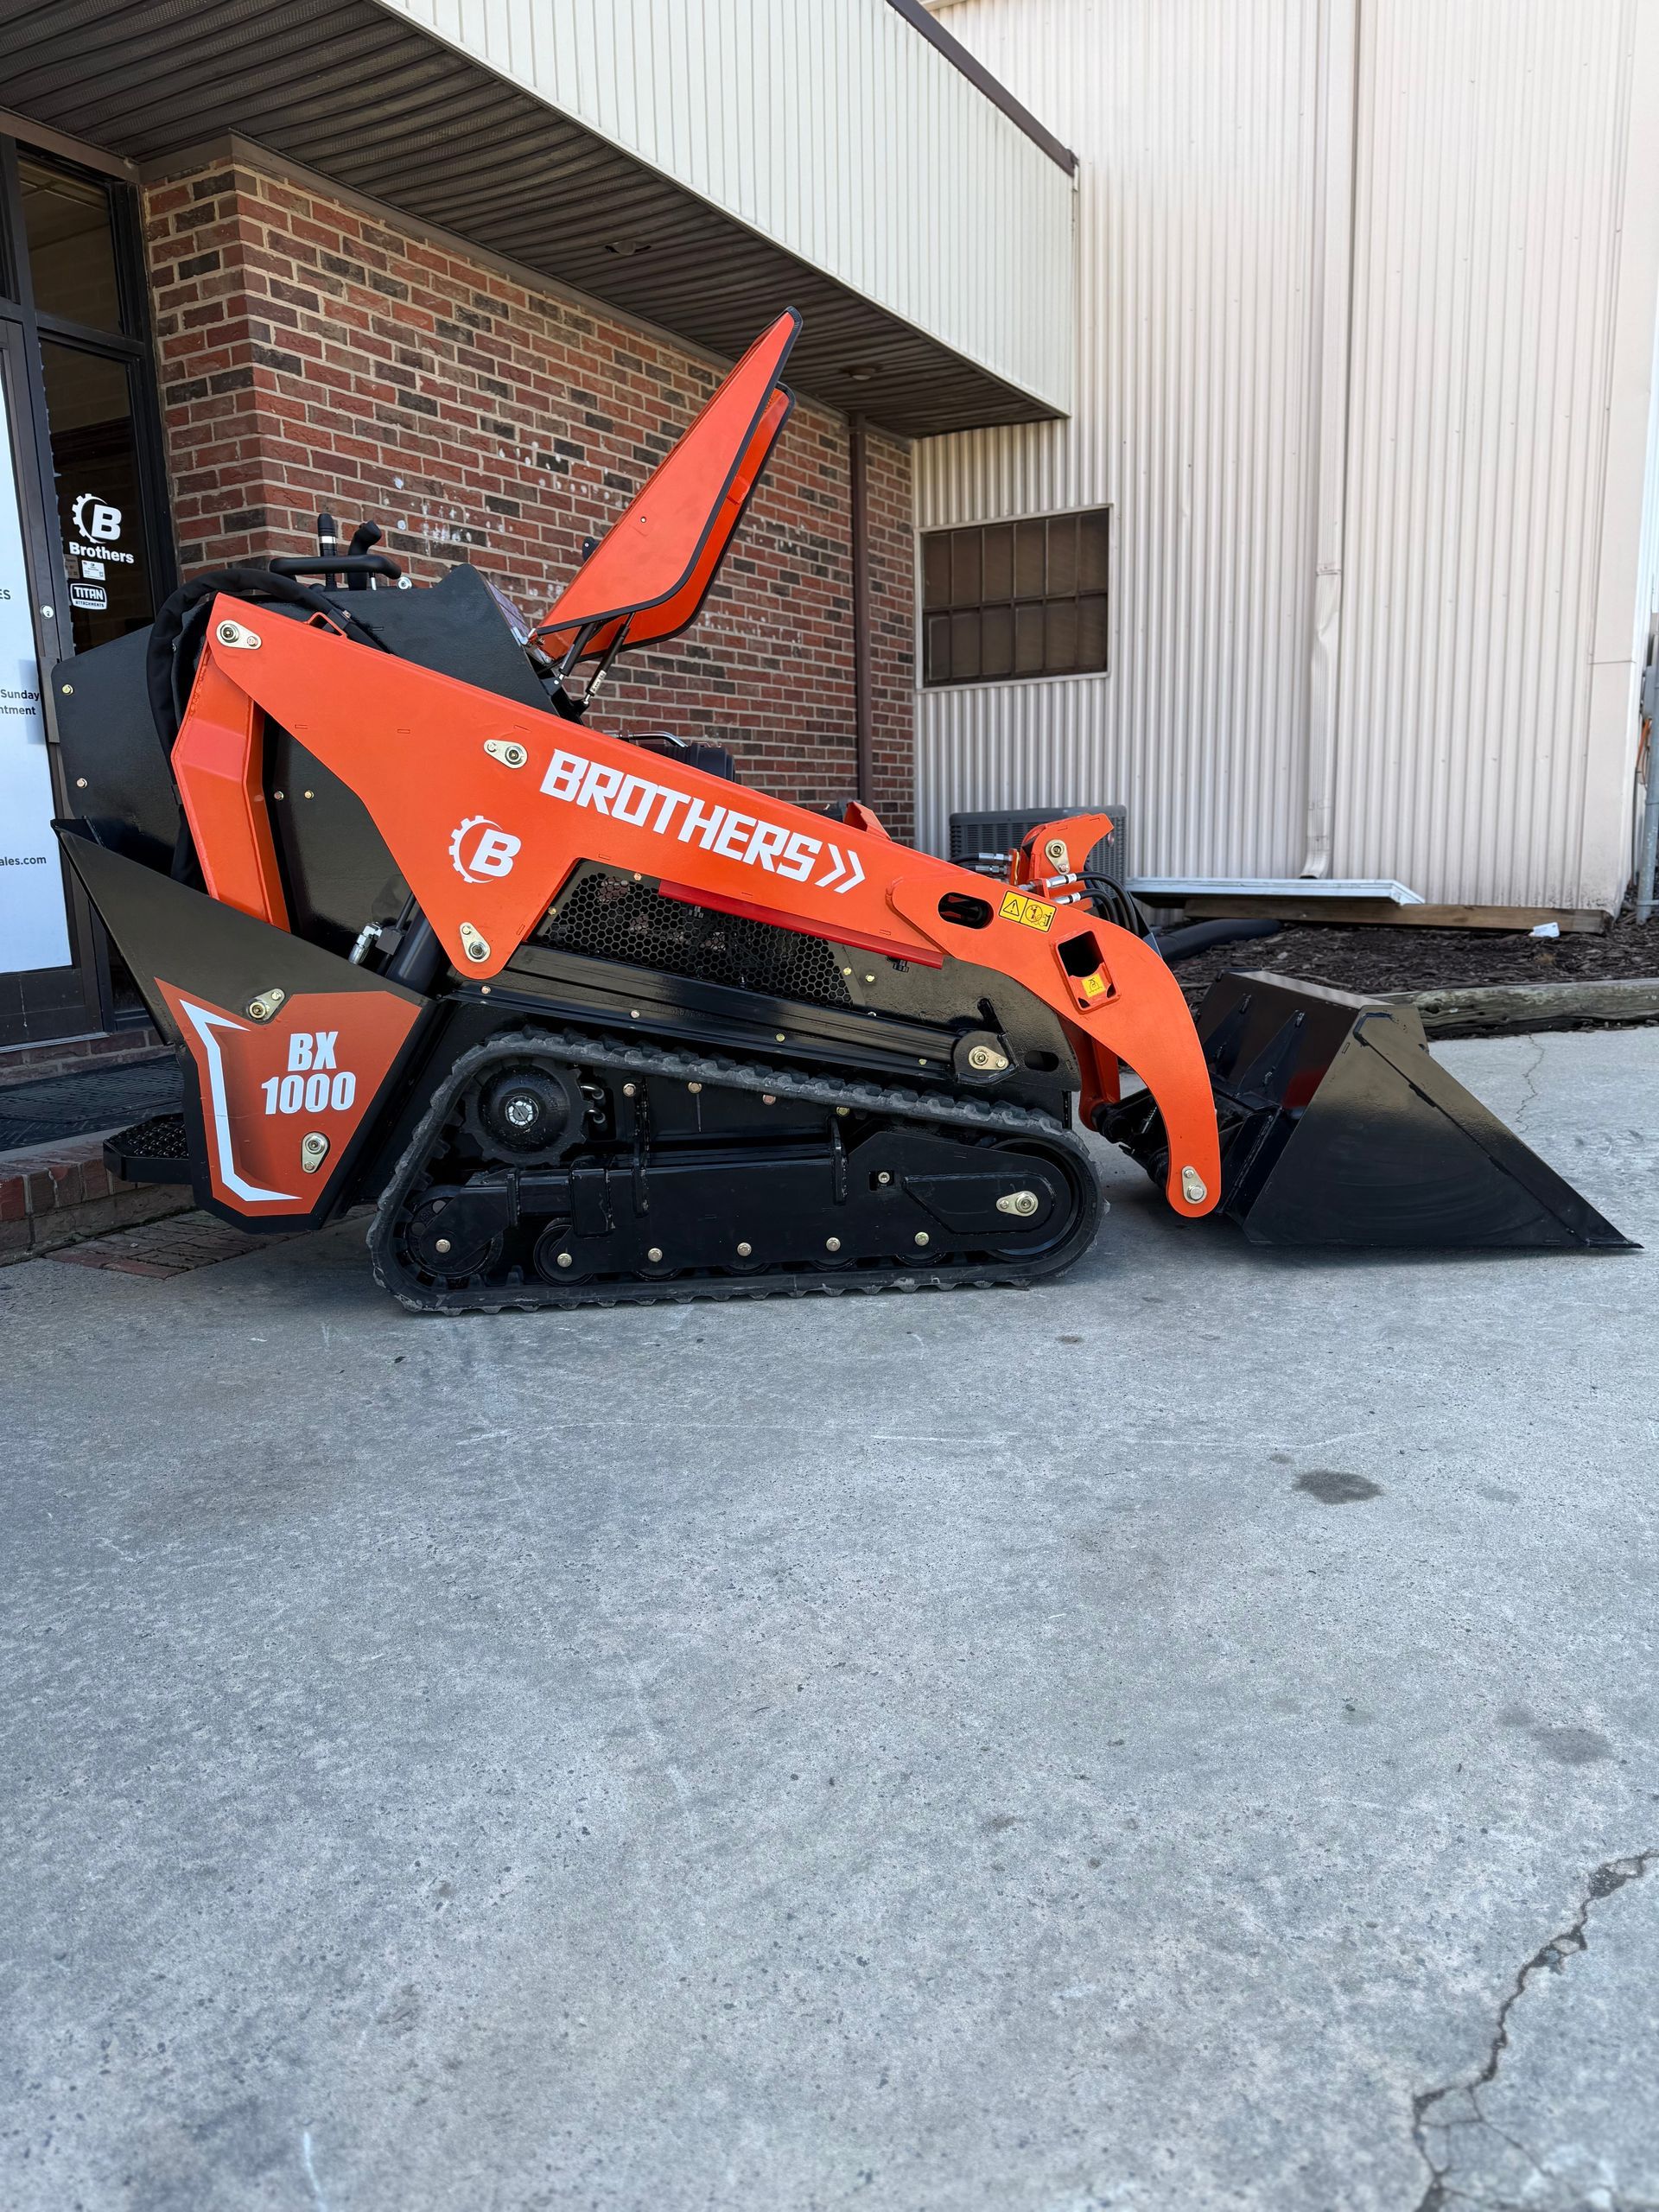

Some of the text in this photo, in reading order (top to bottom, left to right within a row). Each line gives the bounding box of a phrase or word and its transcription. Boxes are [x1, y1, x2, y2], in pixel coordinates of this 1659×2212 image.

[91, 505, 122, 541] B
[69, 542, 135, 564] Brothers
[73, 587, 104, 601] TITAN
[0, 689, 40, 702] Sunday
[539, 748, 823, 883] BROTHERS
[469, 829, 521, 877] B
[287, 1031, 339, 1072] BX
[261, 1071, 357, 1115] 1000
